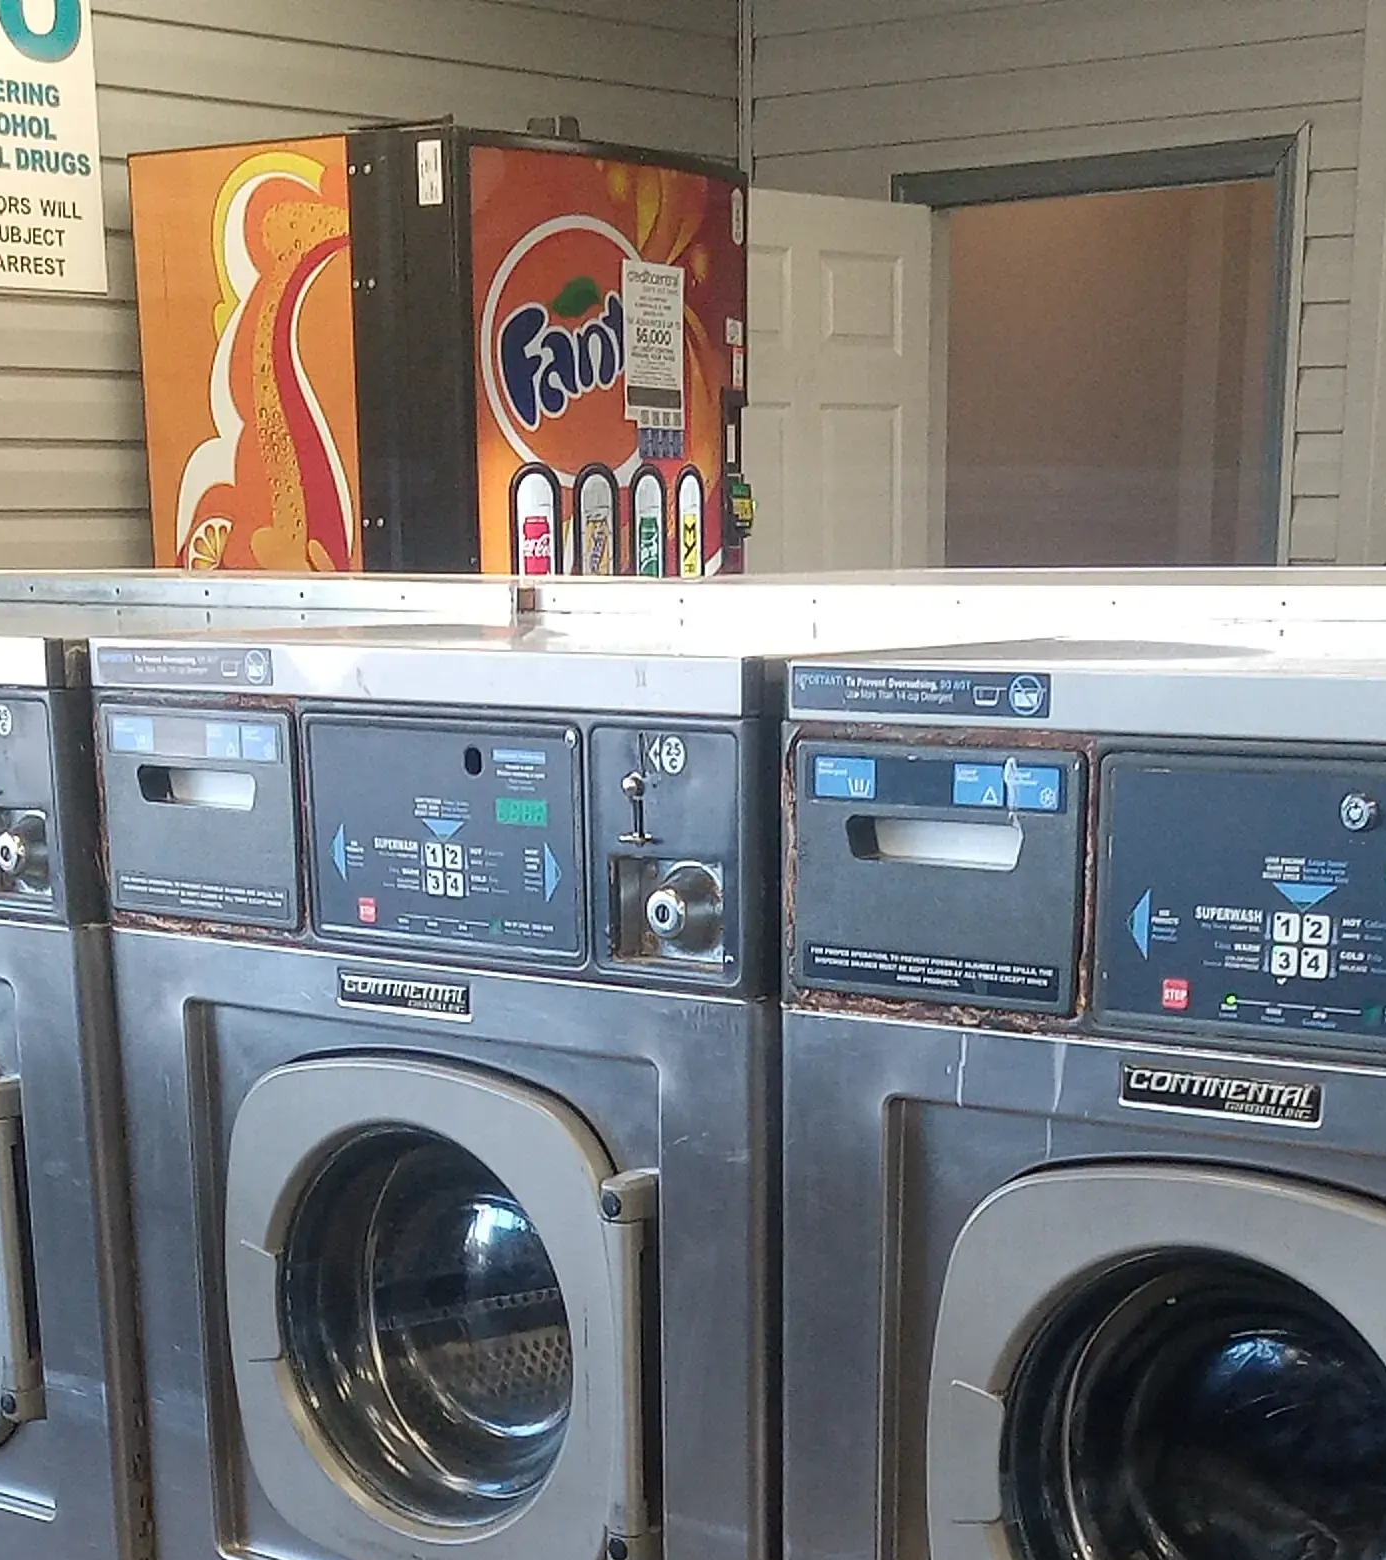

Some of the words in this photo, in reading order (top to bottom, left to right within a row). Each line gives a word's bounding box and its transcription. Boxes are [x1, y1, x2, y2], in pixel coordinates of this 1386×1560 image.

[17, 148, 91, 176] DRUGS
[40, 199, 82, 220] WILL
[665, 742, 681, 756] 25
[1194, 906, 1263, 923] SUPERWASH
[1280, 919, 1291, 937] 1
[1309, 921, 1322, 939] 2
[1278, 952, 1290, 970] 3
[1307, 955, 1320, 972] 4
[1124, 1065, 1314, 1108] CONTINENTAL
